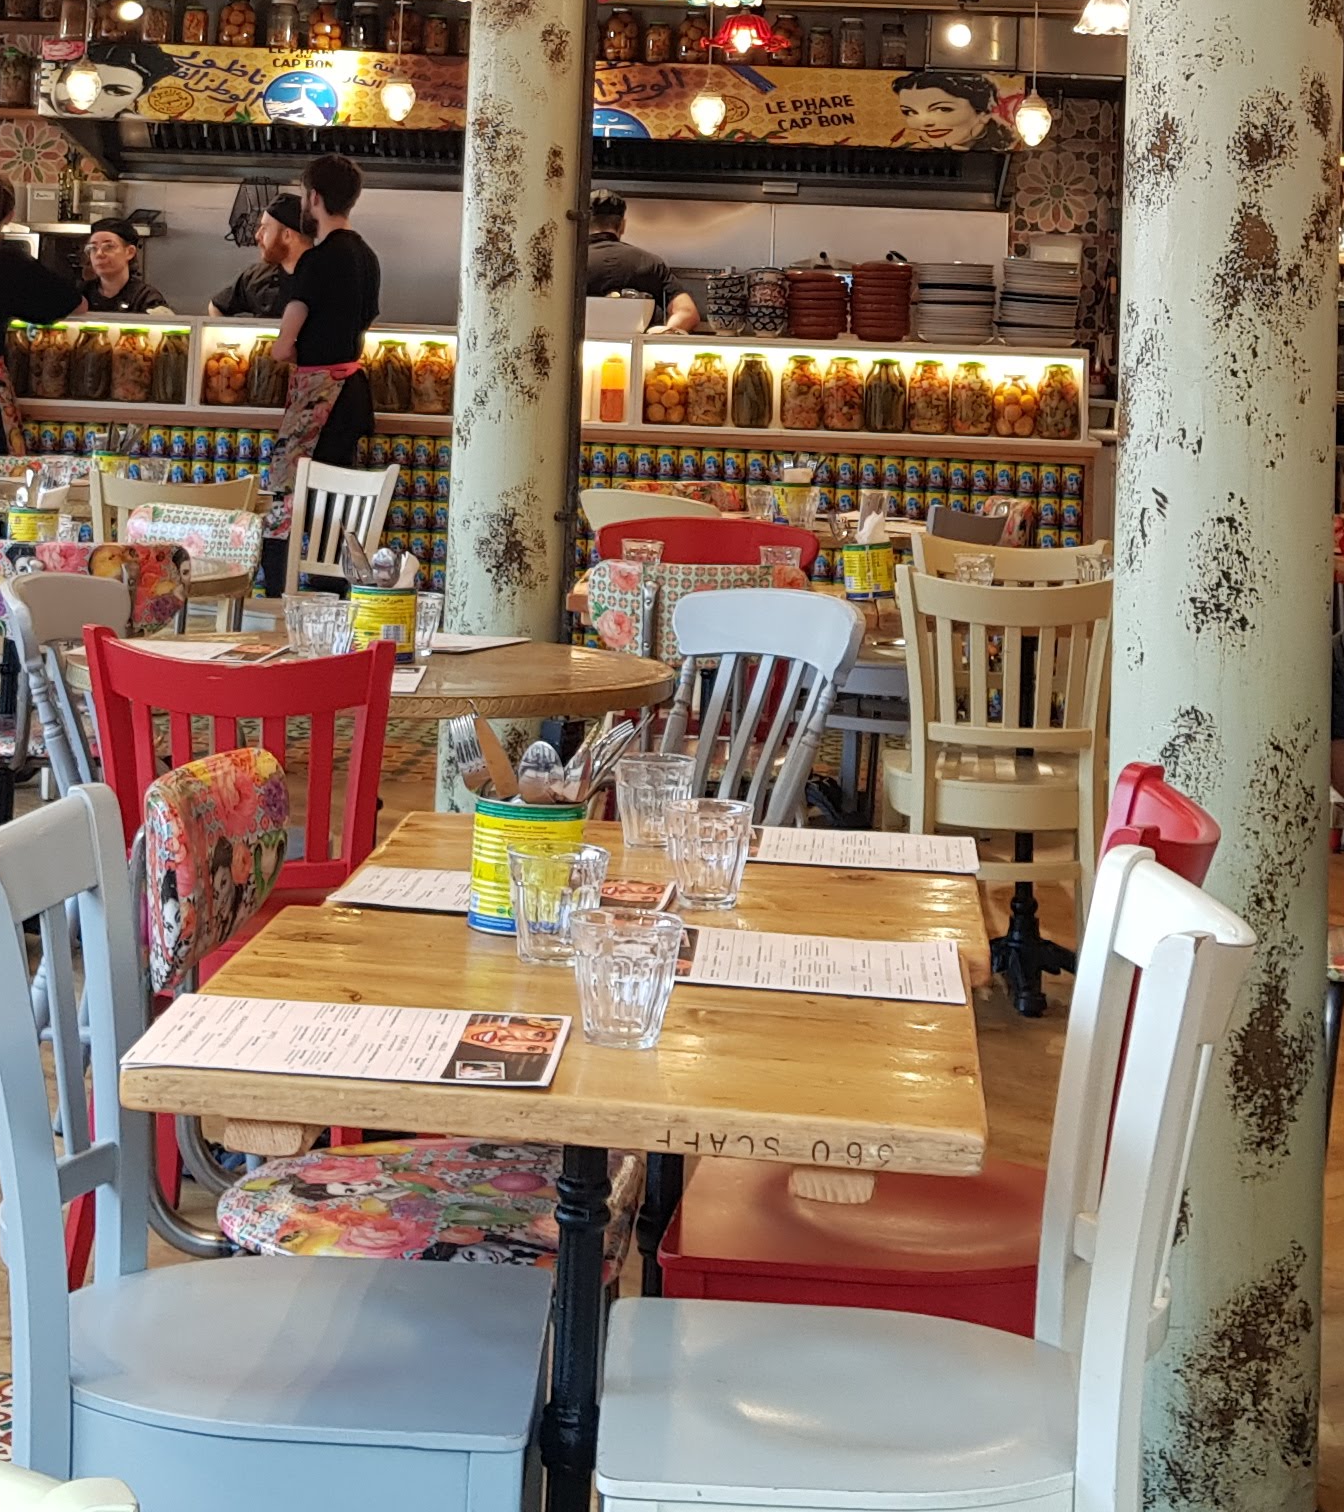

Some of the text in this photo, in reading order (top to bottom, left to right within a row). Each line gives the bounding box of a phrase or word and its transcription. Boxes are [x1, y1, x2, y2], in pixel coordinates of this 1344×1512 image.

[272, 57, 334, 69] CAP BON
[765, 101, 789, 115] LE
[791, 94, 855, 112] PHARE
[777, 113, 855, 132] CAP BON
